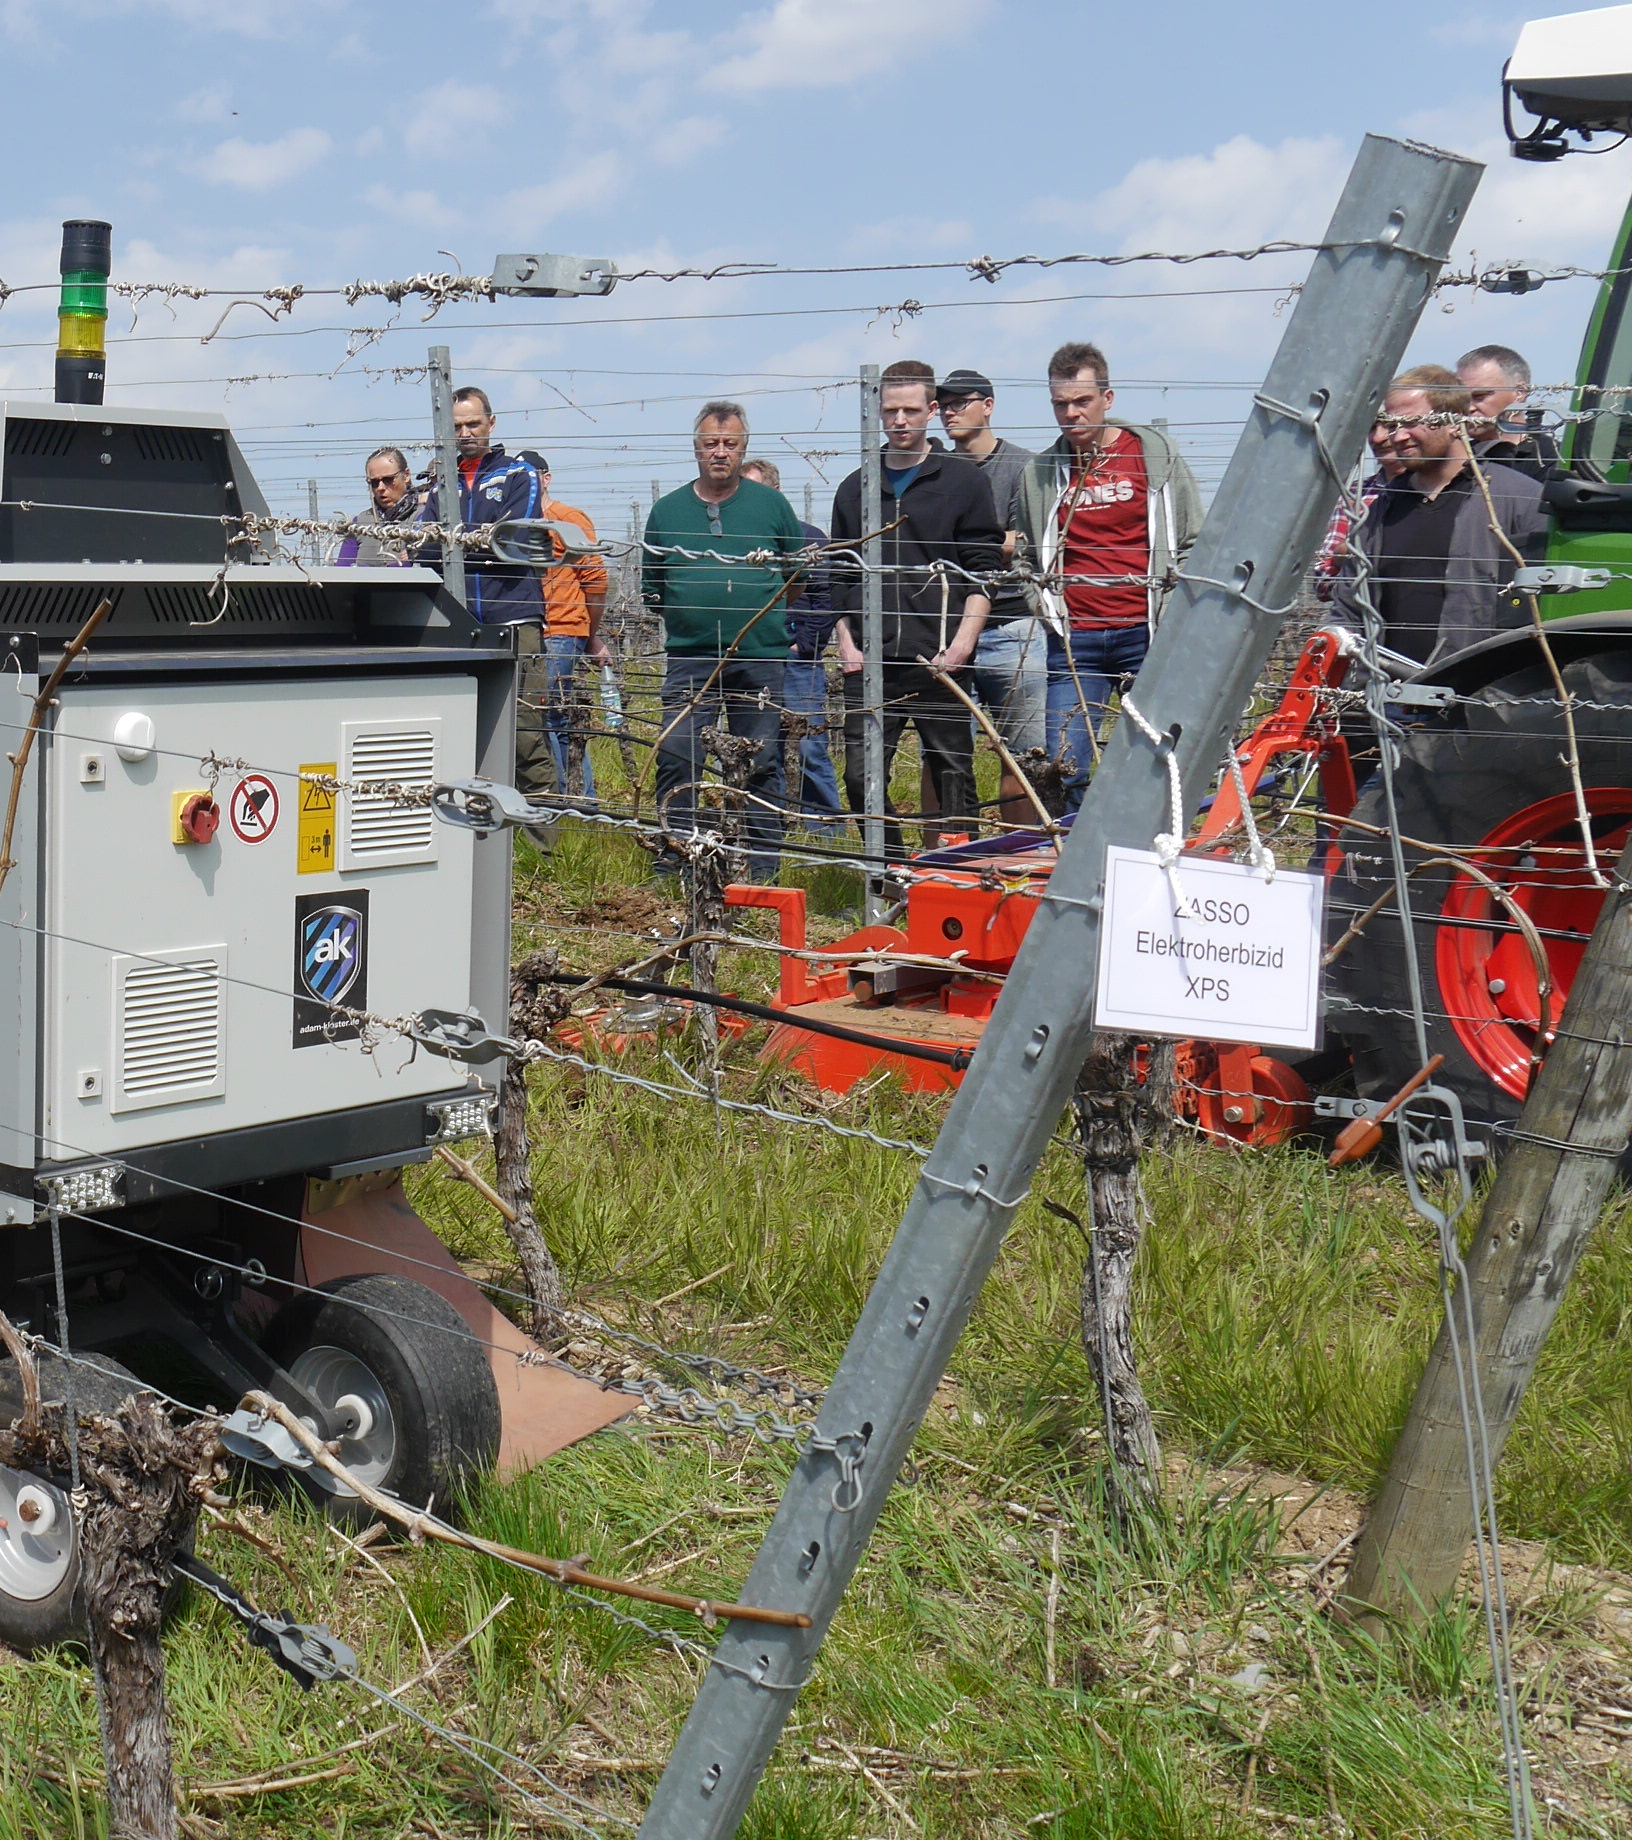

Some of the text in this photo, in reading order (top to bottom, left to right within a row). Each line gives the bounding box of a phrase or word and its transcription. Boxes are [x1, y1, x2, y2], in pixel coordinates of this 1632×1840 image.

[314, 928, 353, 963] ak
[1136, 930, 1284, 969] Elektroherbizid
[1184, 975, 1230, 1002] XPS
